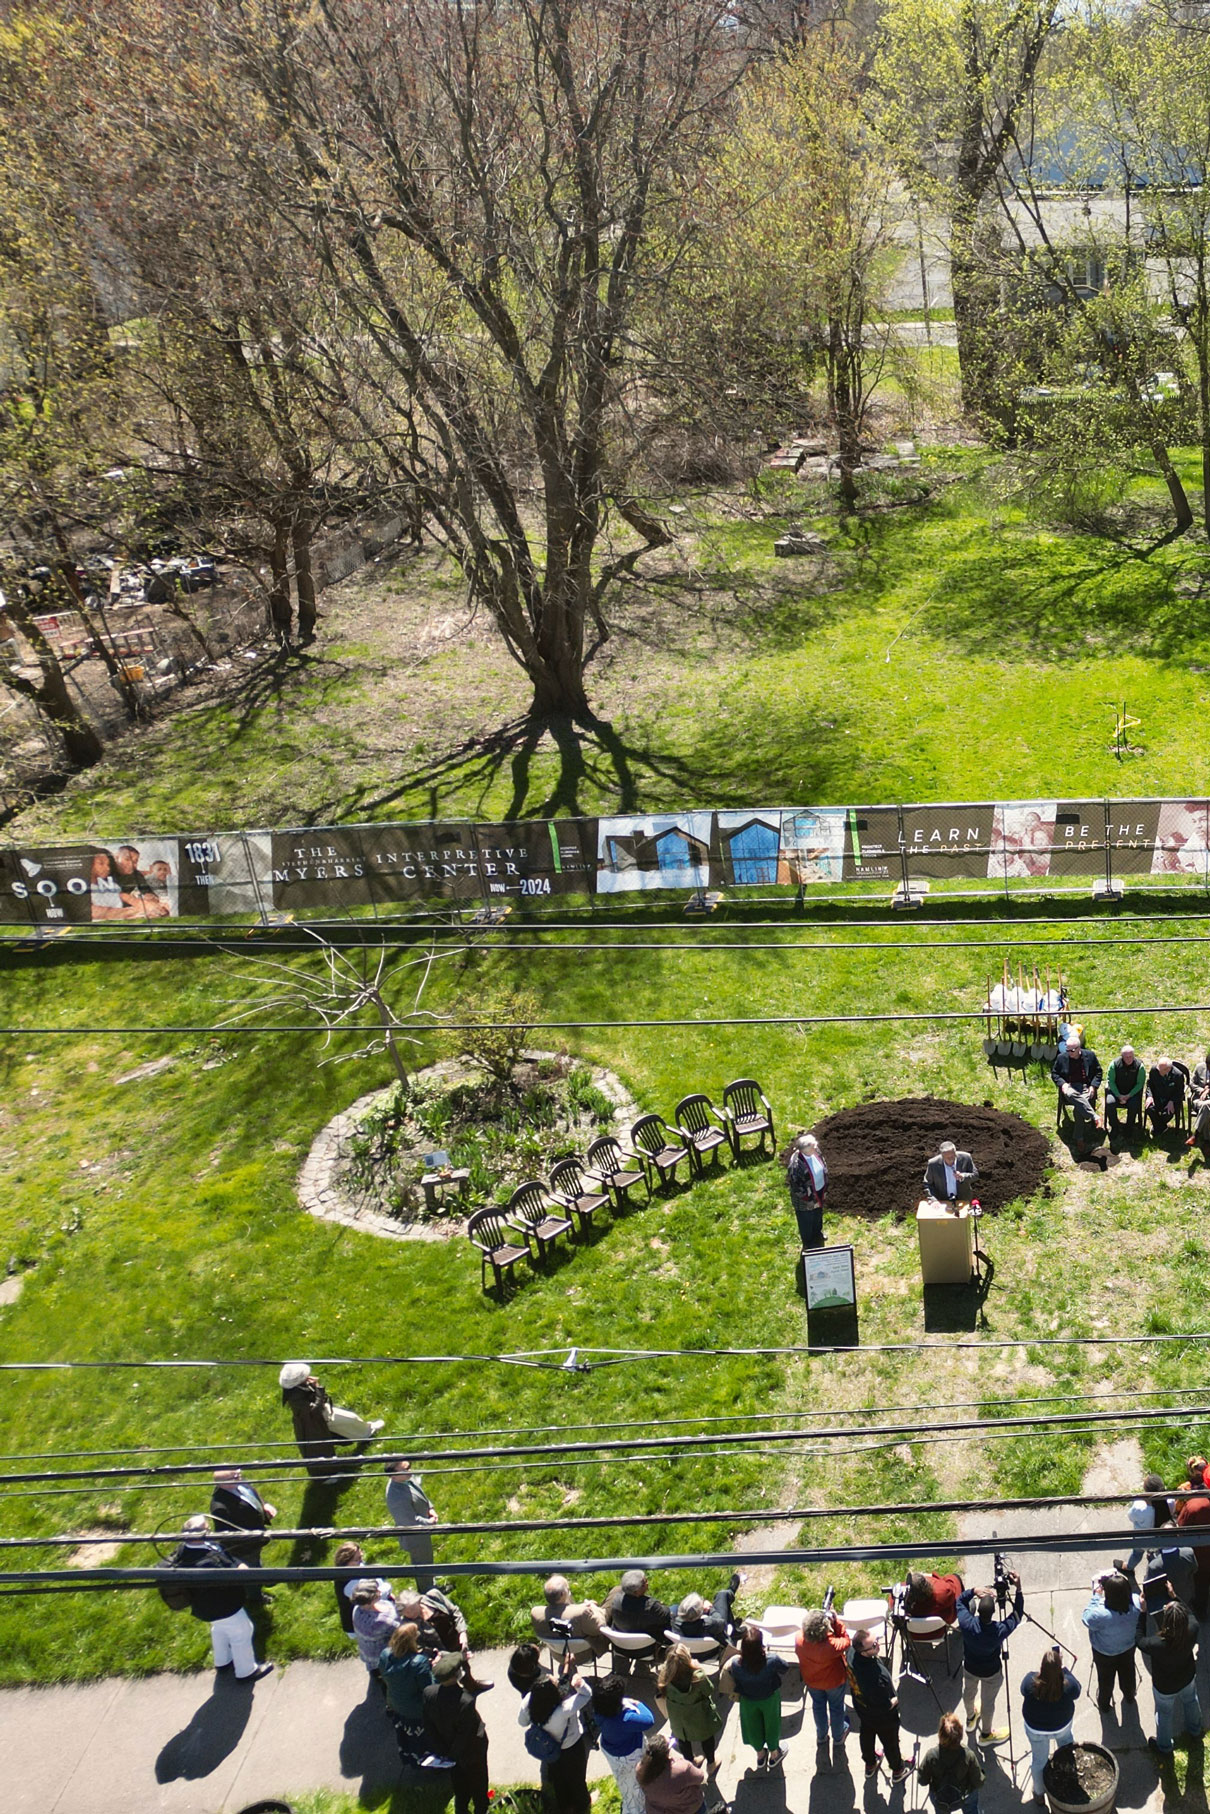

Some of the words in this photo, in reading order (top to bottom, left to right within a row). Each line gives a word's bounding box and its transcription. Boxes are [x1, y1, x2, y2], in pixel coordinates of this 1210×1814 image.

[897, 828, 979, 843] LEARN
[1064, 825, 1090, 837] BE
[1105, 824, 1145, 836] THE
[184, 841, 221, 864] 1831
[293, 846, 337, 859] THE
[376, 848, 528, 864] INTERPRETIVE
[273, 864, 364, 882] MYERS
[402, 862, 521, 879] CENTER
[11, 875, 115, 899] SOON
[519, 878, 552, 895] 2024
